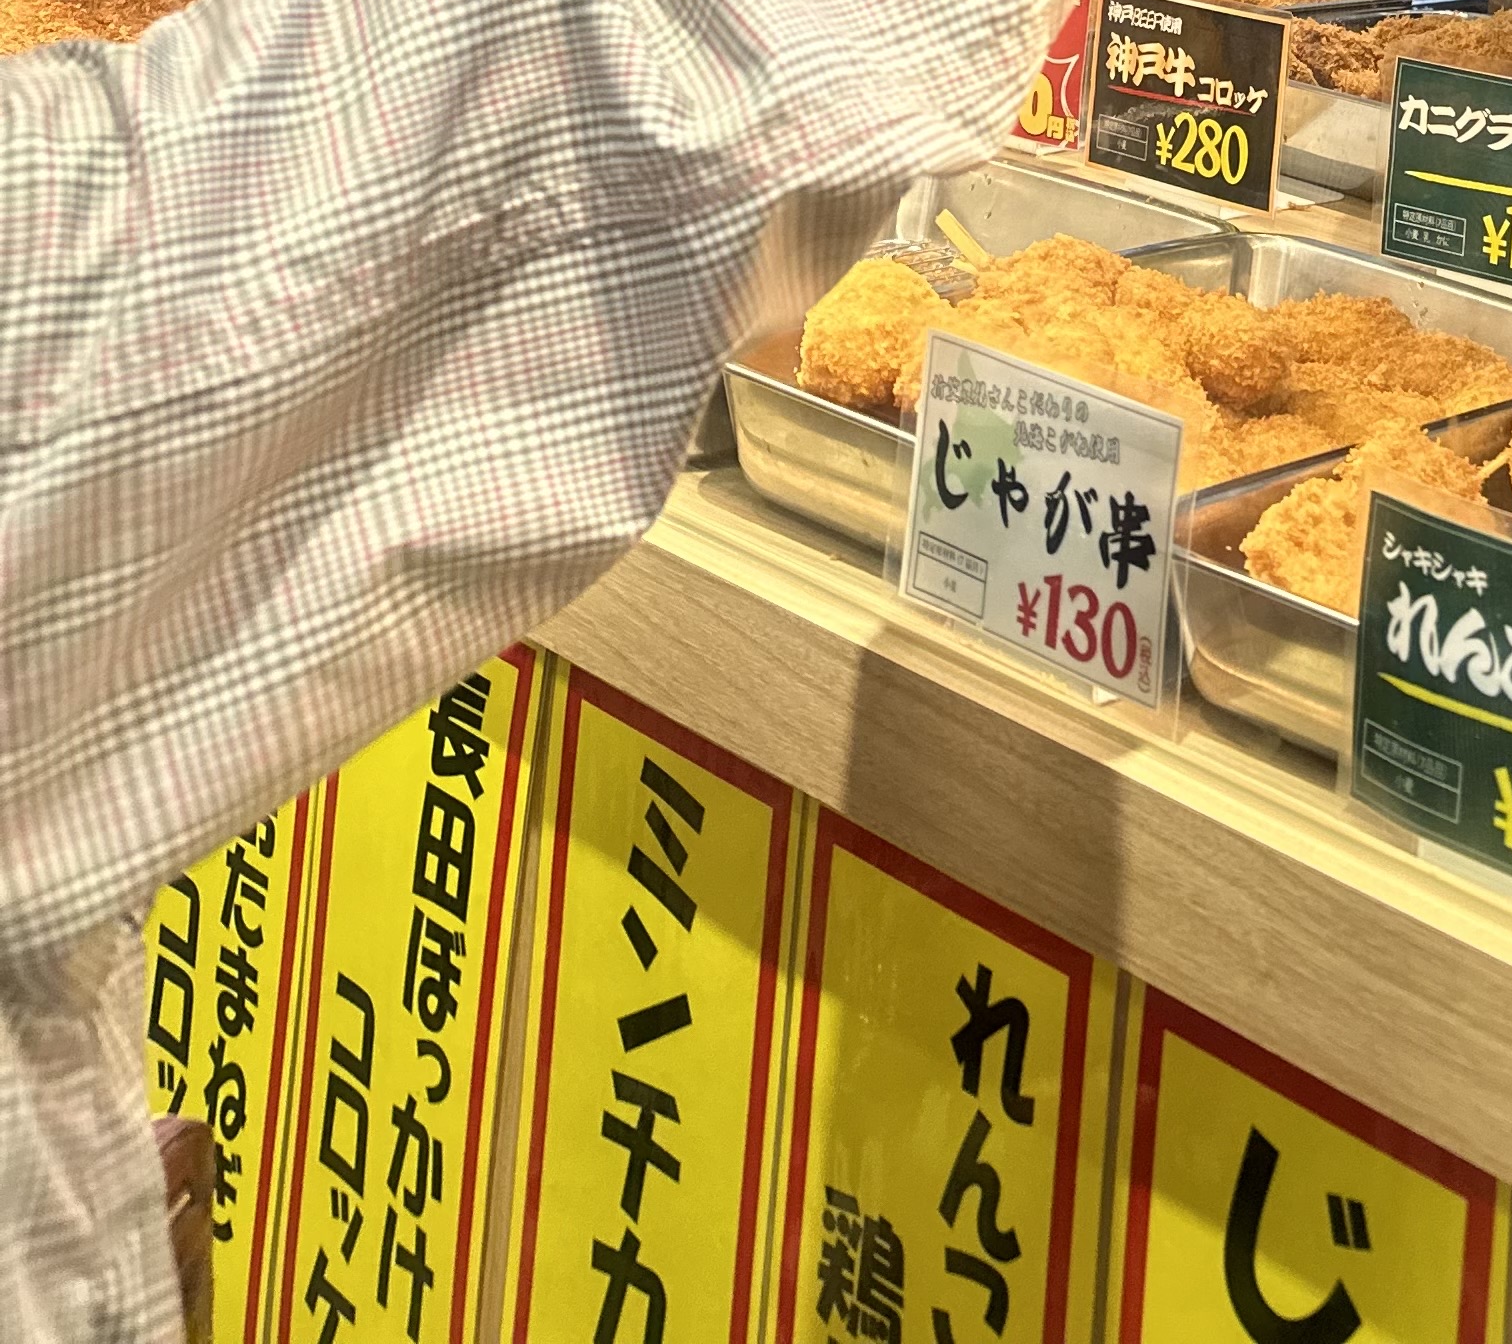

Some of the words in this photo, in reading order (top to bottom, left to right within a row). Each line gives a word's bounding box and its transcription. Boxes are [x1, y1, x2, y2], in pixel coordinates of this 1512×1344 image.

[1155, 111, 1249, 186] ¥280
[934, 418, 1157, 590] じゃが串
[1381, 530, 1488, 598] シャキシャキ
[1016, 573, 1138, 679] ¥130
[815, 1185, 905, 1344] 鶏
[1222, 1124, 1374, 1344] じ
